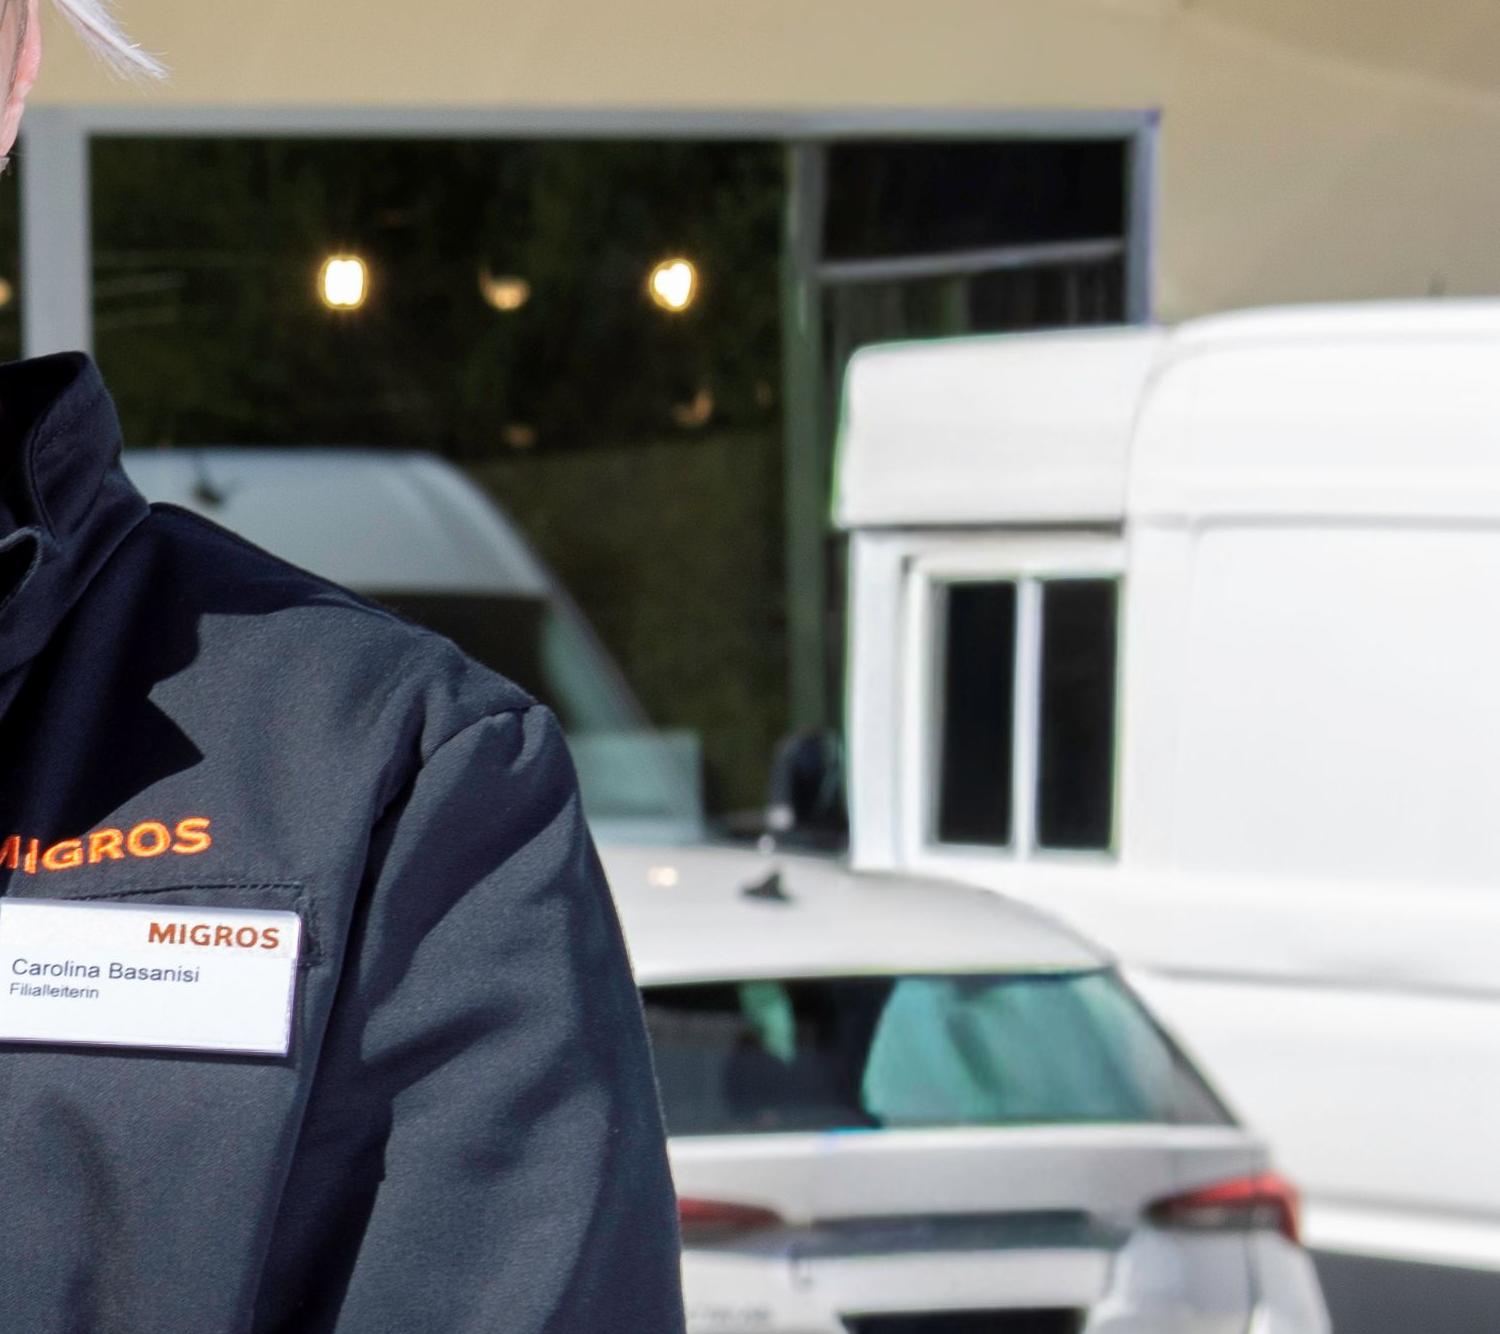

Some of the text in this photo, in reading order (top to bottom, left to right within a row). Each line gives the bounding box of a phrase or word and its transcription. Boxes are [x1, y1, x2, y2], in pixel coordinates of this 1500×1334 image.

[147, 922, 280, 951] MIGROS
[11, 958, 200, 984] Carolina Basanisi
[9, 981, 100, 1001] Filialleiterin
